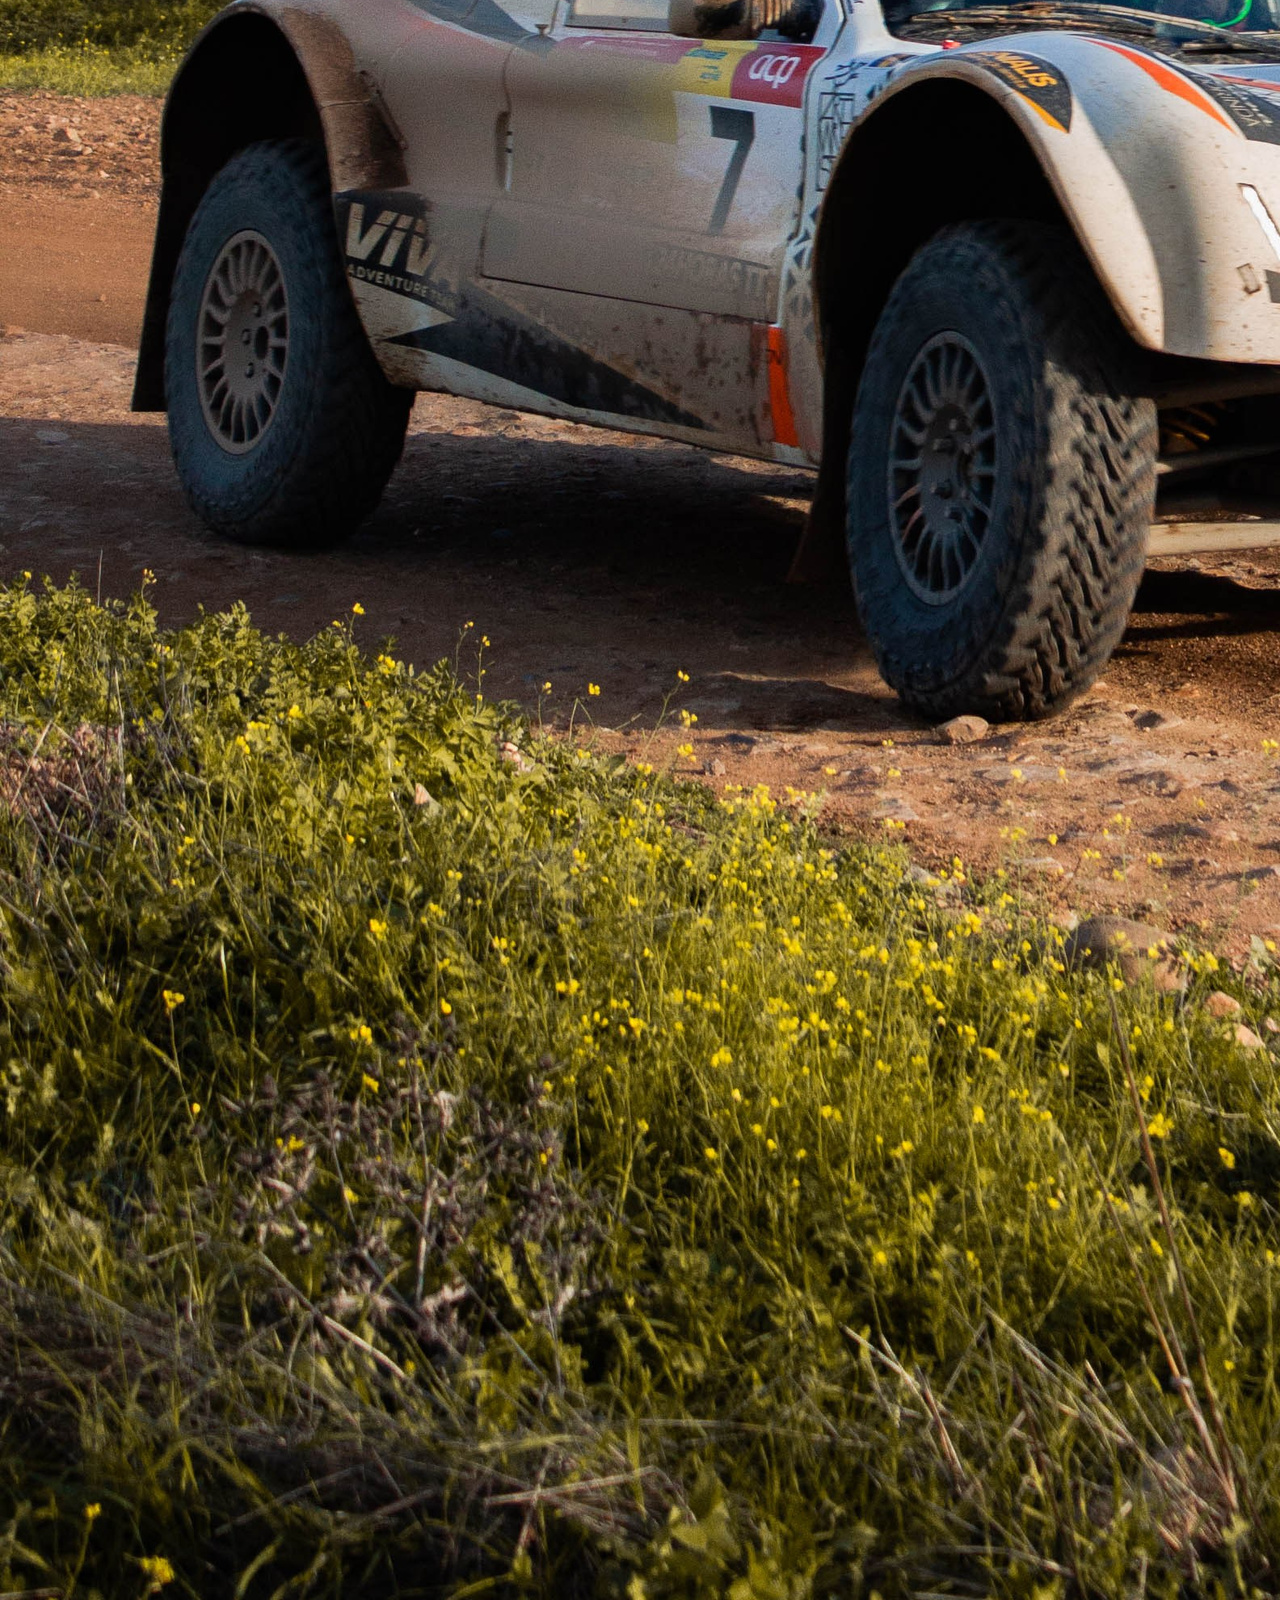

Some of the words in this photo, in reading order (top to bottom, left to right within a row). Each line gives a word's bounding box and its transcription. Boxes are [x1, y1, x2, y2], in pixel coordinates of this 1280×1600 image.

[749, 54, 801, 89] acp
[709, 105, 756, 237] 7
[345, 202, 443, 277] VIV
